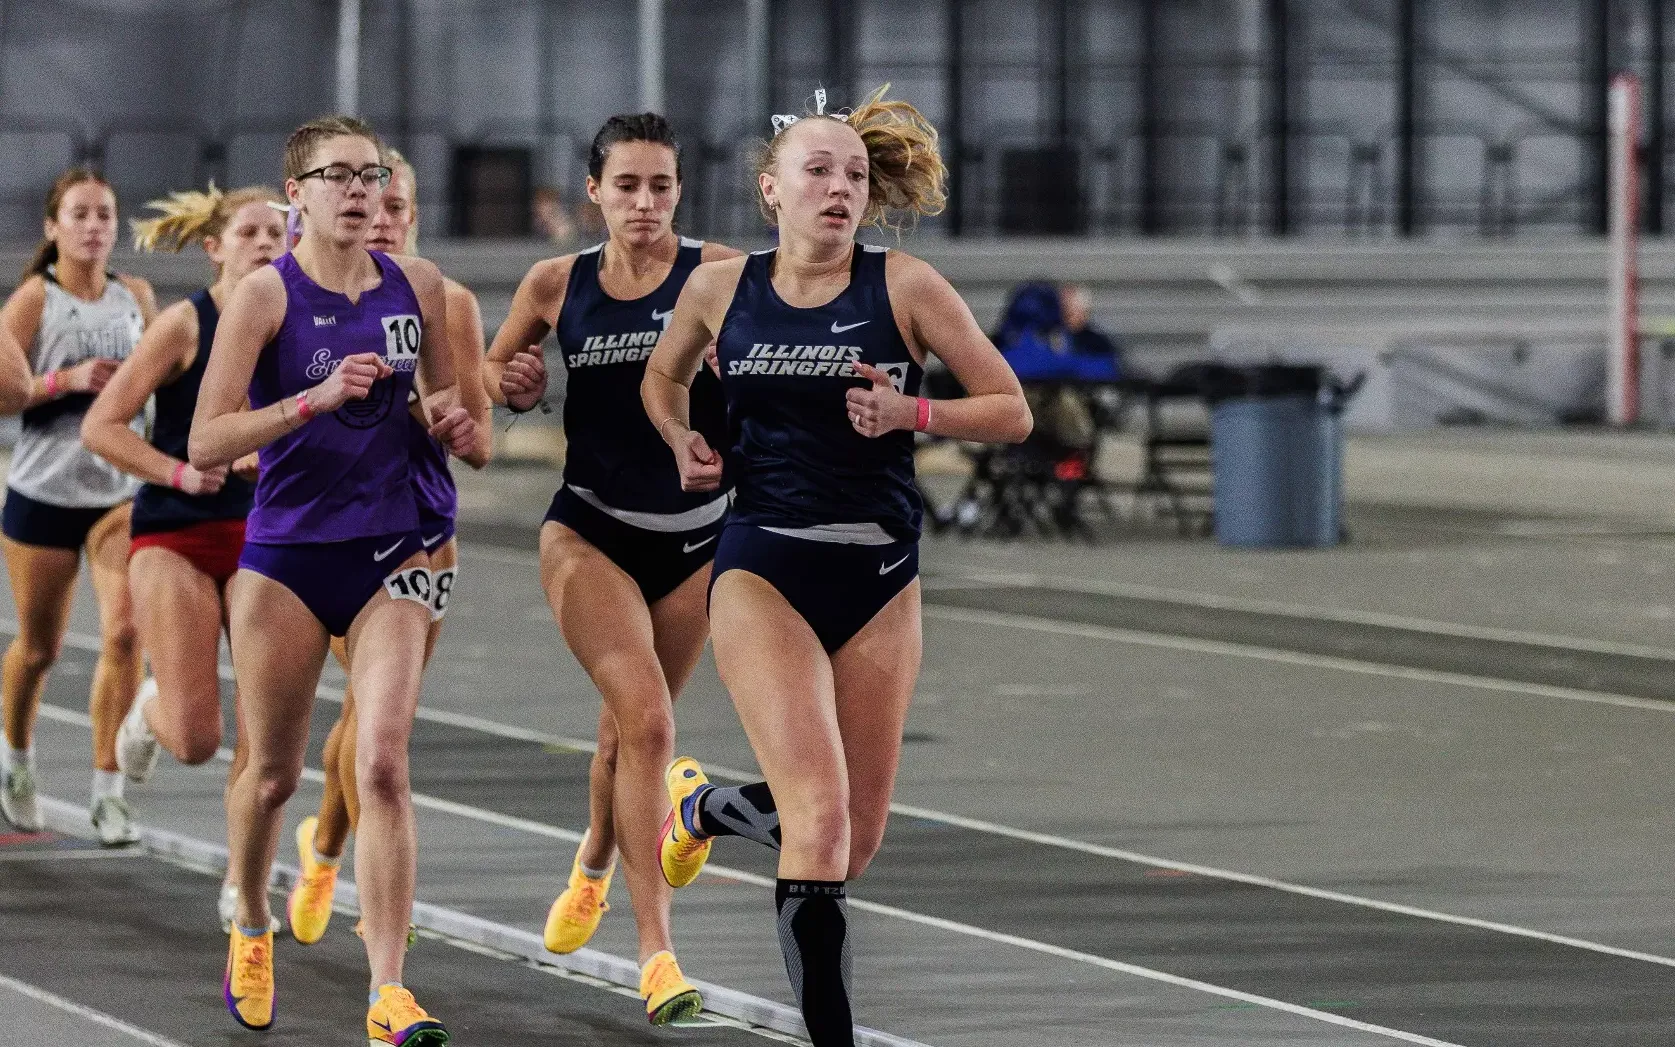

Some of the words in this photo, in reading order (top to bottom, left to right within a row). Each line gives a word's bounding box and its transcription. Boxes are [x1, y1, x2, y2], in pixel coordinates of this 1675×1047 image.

[389, 318, 420, 354] 10
[582, 331, 661, 352] ILLINO
[568, 347, 655, 368] SPRINGF
[746, 343, 863, 361] ILLINOIS
[728, 360, 869, 378] SPRINGFIE
